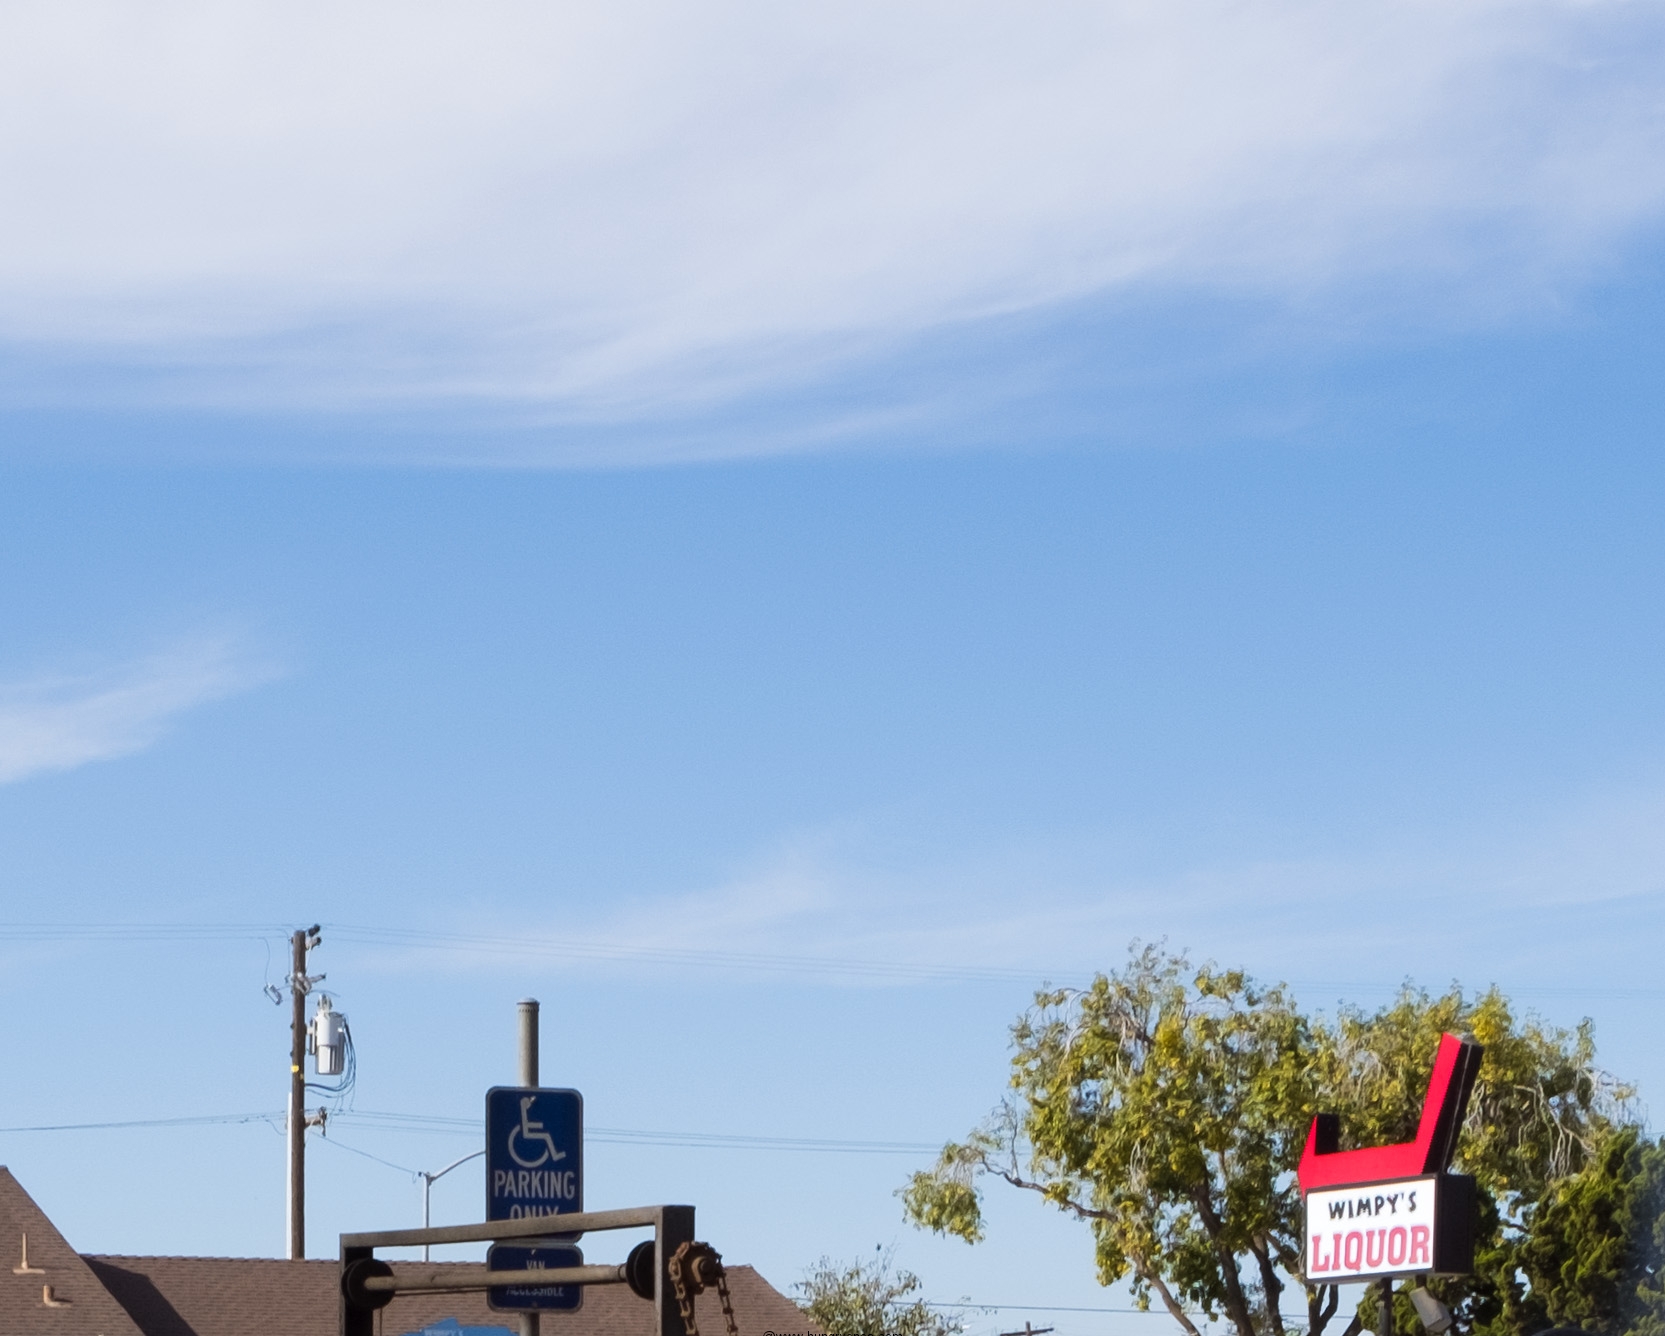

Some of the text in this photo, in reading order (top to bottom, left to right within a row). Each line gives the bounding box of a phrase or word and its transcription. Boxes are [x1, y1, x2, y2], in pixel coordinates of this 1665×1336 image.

[494, 1169, 576, 1200] PARKING
[1328, 1191, 1417, 1220] WIMPY'S
[1311, 1225, 1431, 1272] LIQUOR
